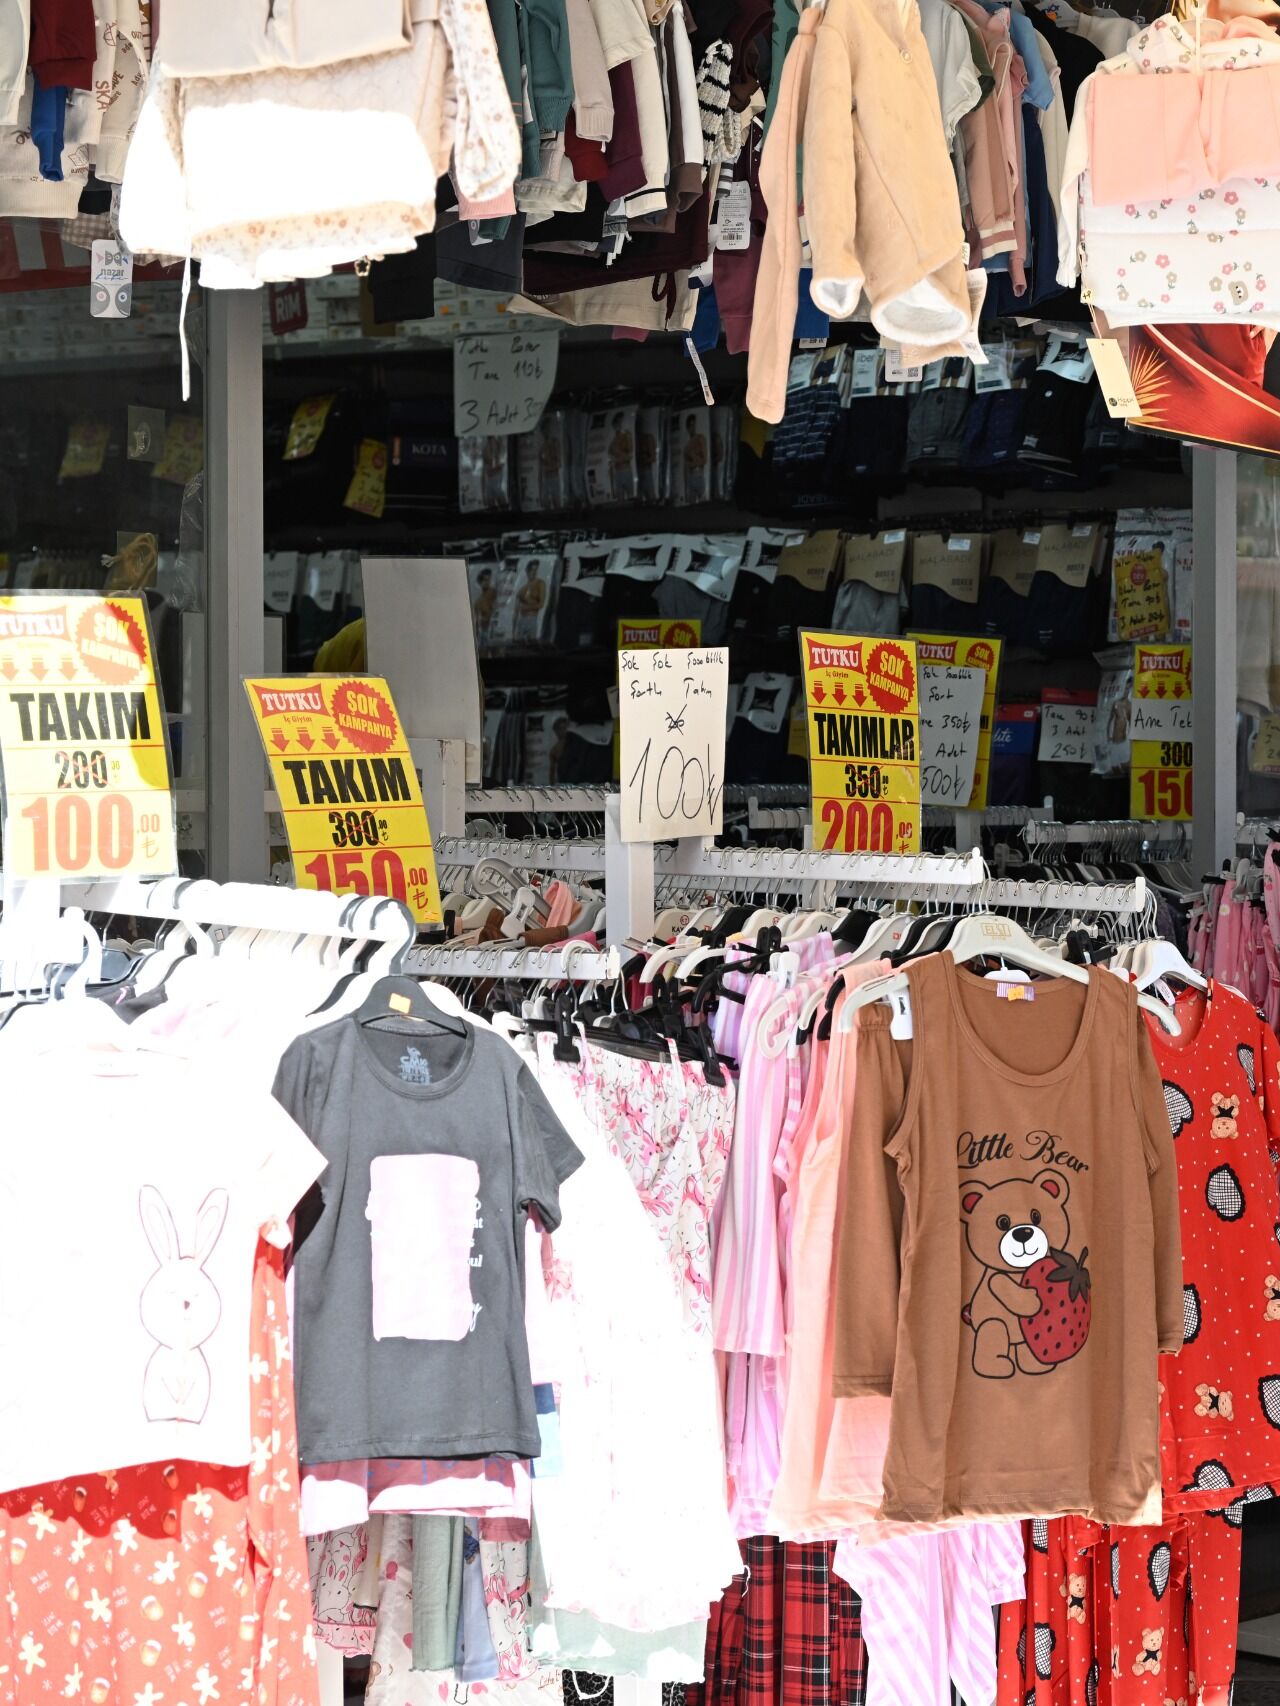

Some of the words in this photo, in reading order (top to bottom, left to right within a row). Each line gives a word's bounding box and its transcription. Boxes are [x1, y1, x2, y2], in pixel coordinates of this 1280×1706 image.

[460, 400, 480, 434] 3
[624, 629, 659, 643] TUTKU
[811, 646, 860, 668] TUTKU
[879, 650, 905, 680] ŞOK
[1141, 655, 1181, 670] TUTKU
[262, 692, 321, 711] TUTKU
[870, 672, 910, 702] KAMPANYA
[9, 692, 151, 742] TAKIM
[346, 690, 380, 719] ŞOK
[338, 713, 392, 740] KAMPANYA
[813, 712, 915, 761] TAKIMLAR
[55, 750, 109, 790] 200
[1160, 742, 1192, 767] 300
[283, 757, 412, 804] TAKIM
[844, 764, 881, 799] 350
[22, 794, 134, 871] 100
[328, 810, 380, 848] 300
[821, 799, 894, 854] 200
[305, 850, 408, 905] 150
[956, 1131, 1015, 1169] Little
[1020, 1130, 1089, 1174] Bear
